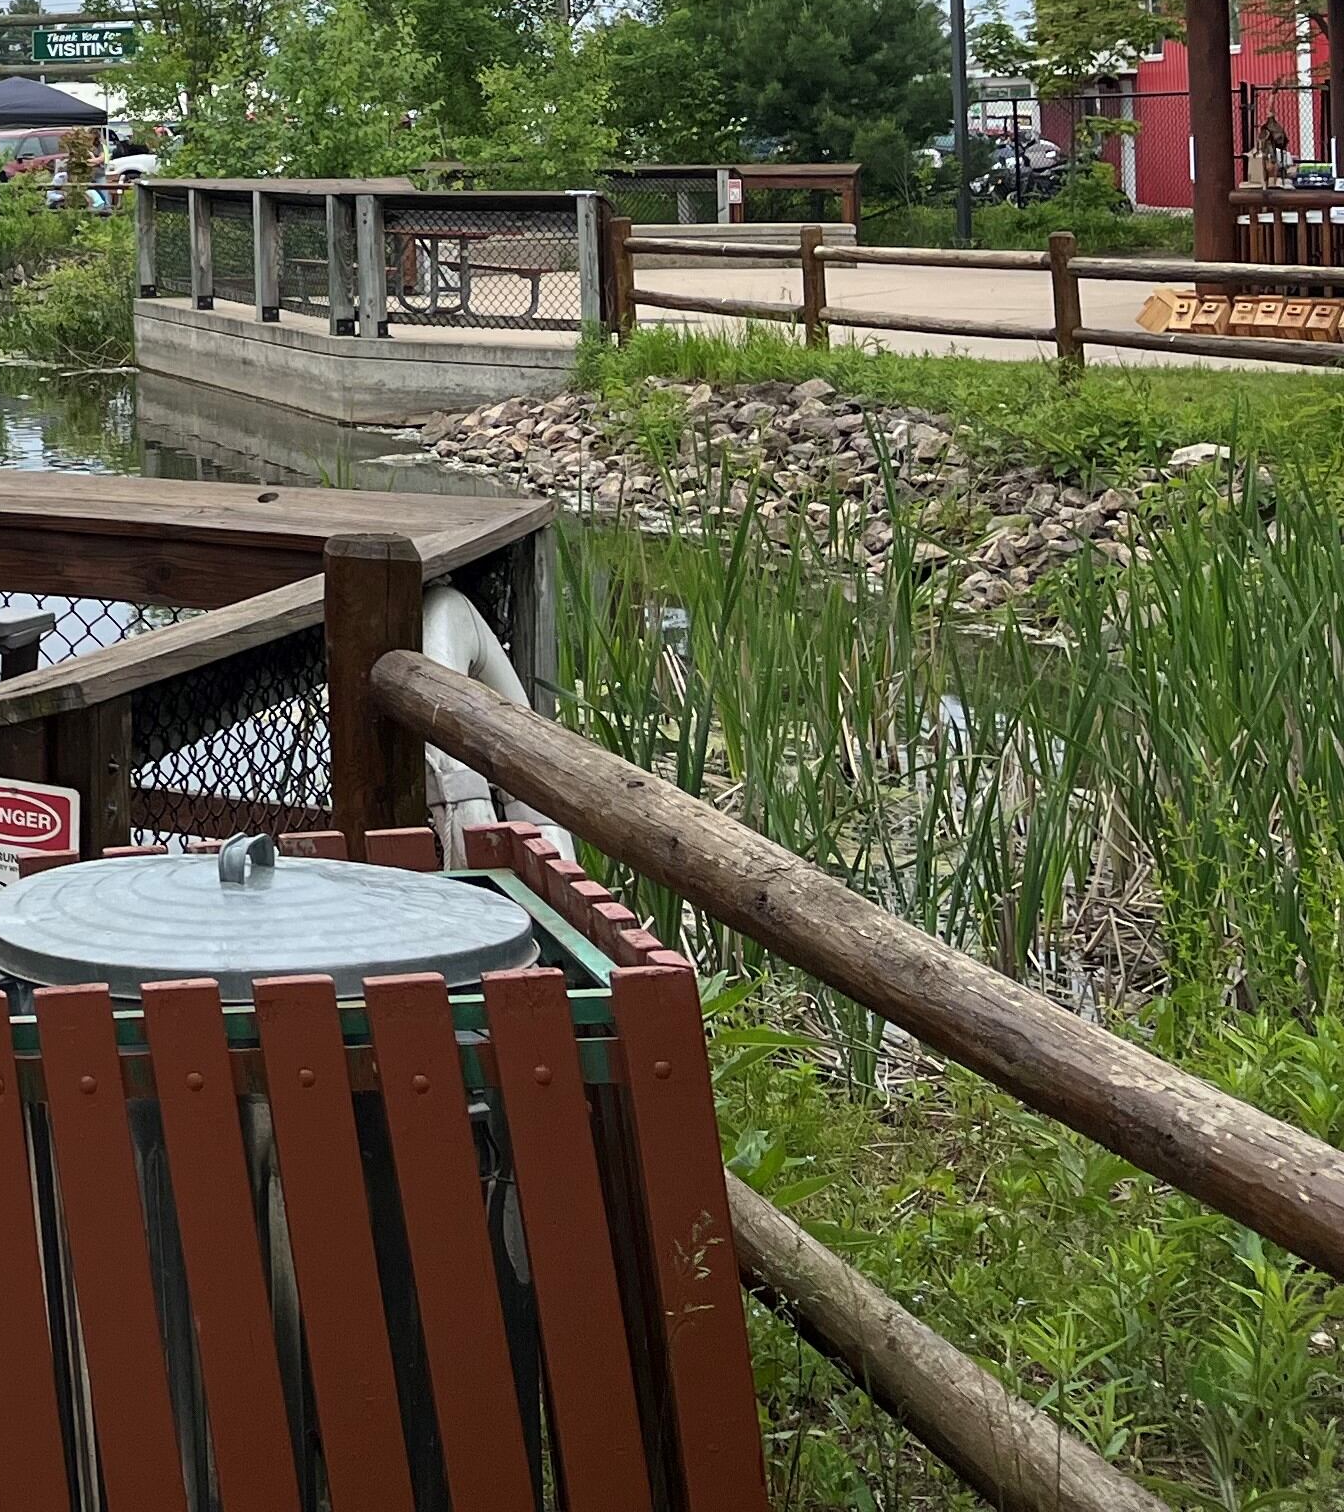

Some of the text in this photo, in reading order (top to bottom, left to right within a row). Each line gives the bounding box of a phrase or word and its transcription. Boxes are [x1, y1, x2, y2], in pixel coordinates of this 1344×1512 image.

[47, 33, 78, 42] Thank
[81, 32, 99, 41] You
[46, 42, 123, 56] VISITING
